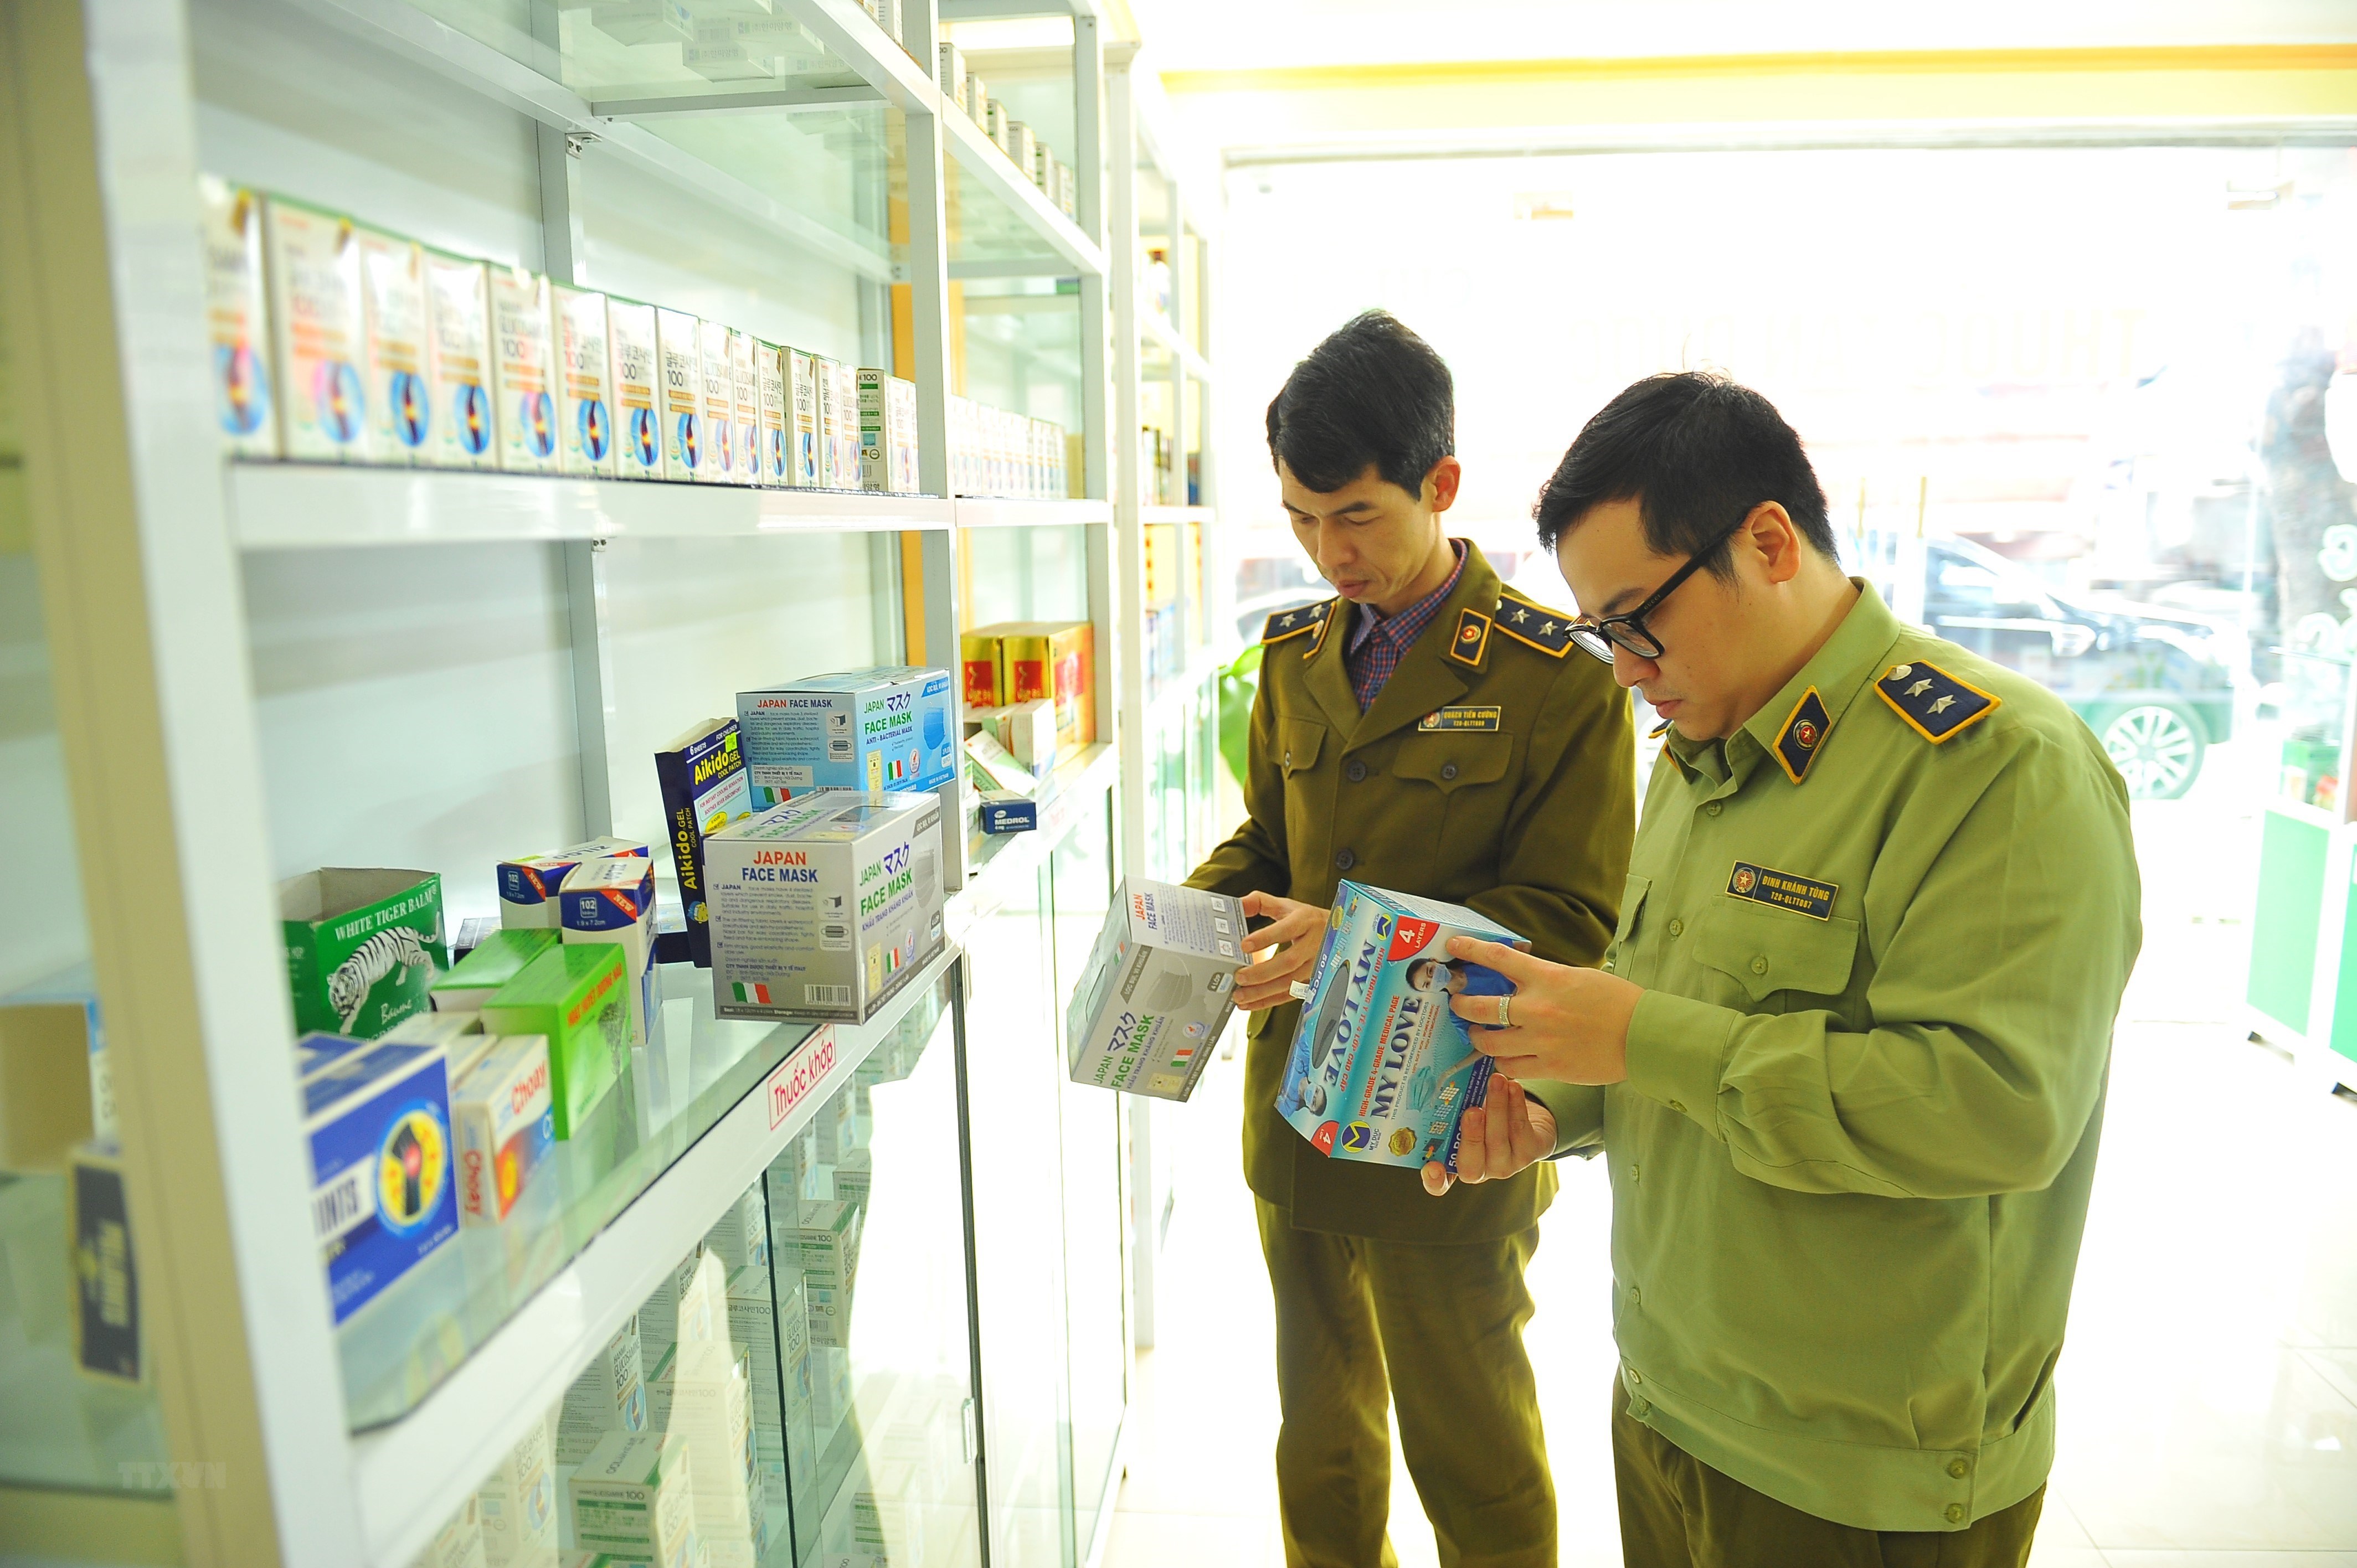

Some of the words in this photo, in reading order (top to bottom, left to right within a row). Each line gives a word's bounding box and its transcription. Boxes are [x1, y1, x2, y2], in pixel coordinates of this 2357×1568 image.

[667, 370, 683, 386] 100
[706, 379, 719, 394] 100
[763, 393, 774, 407] 100
[796, 398, 806, 411] 100
[790, 699, 808, 708] FACE
[810, 699, 832, 708] MASK
[864, 699, 884, 714] JAPAN
[887, 692, 911, 713] マスク
[864, 718, 887, 735] FACE
[889, 711, 913, 729] MASK
[866, 736, 876, 745] ANTI
[880, 730, 901, 742] BACTERIAL
[902, 726, 913, 735] MASK
[689, 746, 694, 755] 6
[694, 742, 707, 754] SHEETS
[694, 750, 729, 785] Aikido
[729, 750, 740, 762] GEL
[718, 767, 729, 779] COOL
[728, 760, 742, 772] PATCH
[677, 808, 686, 827] GEL
[994, 817, 1030, 825] MEDROL
[676, 831, 697, 889] Aikido
[754, 851, 806, 865] JAPAN
[883, 841, 909, 875] マスク
[508, 873, 518, 883] 102
[530, 872, 543, 890] NEW
[742, 868, 775, 881] FACE
[780, 868, 818, 882] MASK
[860, 860, 882, 886] JAPAN
[861, 886, 885, 916] FACE
[888, 868, 913, 899] MASK
[1781, 881, 1808, 895] KHÁNH
[1809, 886, 1830, 901] TÙNG
[580, 900, 595, 910] 102
[613, 894, 635, 912] NEW
[1134, 894, 1146, 920] JAPAN
[1145, 893, 1155, 911] MASK
[335, 914, 373, 941] WHITE
[375, 902, 407, 926] TIGER
[1147, 911, 1157, 930] FACE
[1399, 929, 1416, 943] 4
[1414, 922, 1427, 948] LAYERS
[1320, 952, 1328, 968] 50
[1354, 939, 1376, 996] MY
[1374, 947, 1385, 973] KHẨU
[1365, 974, 1378, 1004] TRANG
[380, 999, 412, 1025] Baume
[1107, 1011, 1136, 1052] マスク
[1324, 997, 1360, 1086] LOVE
[1111, 1056, 1135, 1089] FACE
[1128, 1014, 1155, 1053] MASK
[1358, 1074, 1376, 1117] HIGH-GRADE
[1371, 1045, 1385, 1075] 4-GRADE
[1380, 1015, 1394, 1045] MEDICAL
[1389, 995, 1400, 1015] PAGE
[1370, 1075, 1398, 1120] MY
[1385, 998, 1422, 1071] LOVE
[1395, 1083, 1405, 1108] PRODUCT
[1405, 1037, 1417, 1075] RECOMENDED
[1419, 1002, 1429, 1030] DOCTORS
[1093, 1055, 1114, 1084] JAPAN
[1345, 1053, 1355, 1071] CAO
[775, 1061, 806, 1116] Thuốc
[809, 1039, 833, 1082] khớp
[1324, 1133, 1331, 1144] 4
[1369, 1141, 1375, 1151] MY
[788, 1334, 800, 1353] 100
[614, 1345, 627, 1365] HANMI
[616, 1369, 629, 1390] 100
[626, 1490, 646, 1500] 100
